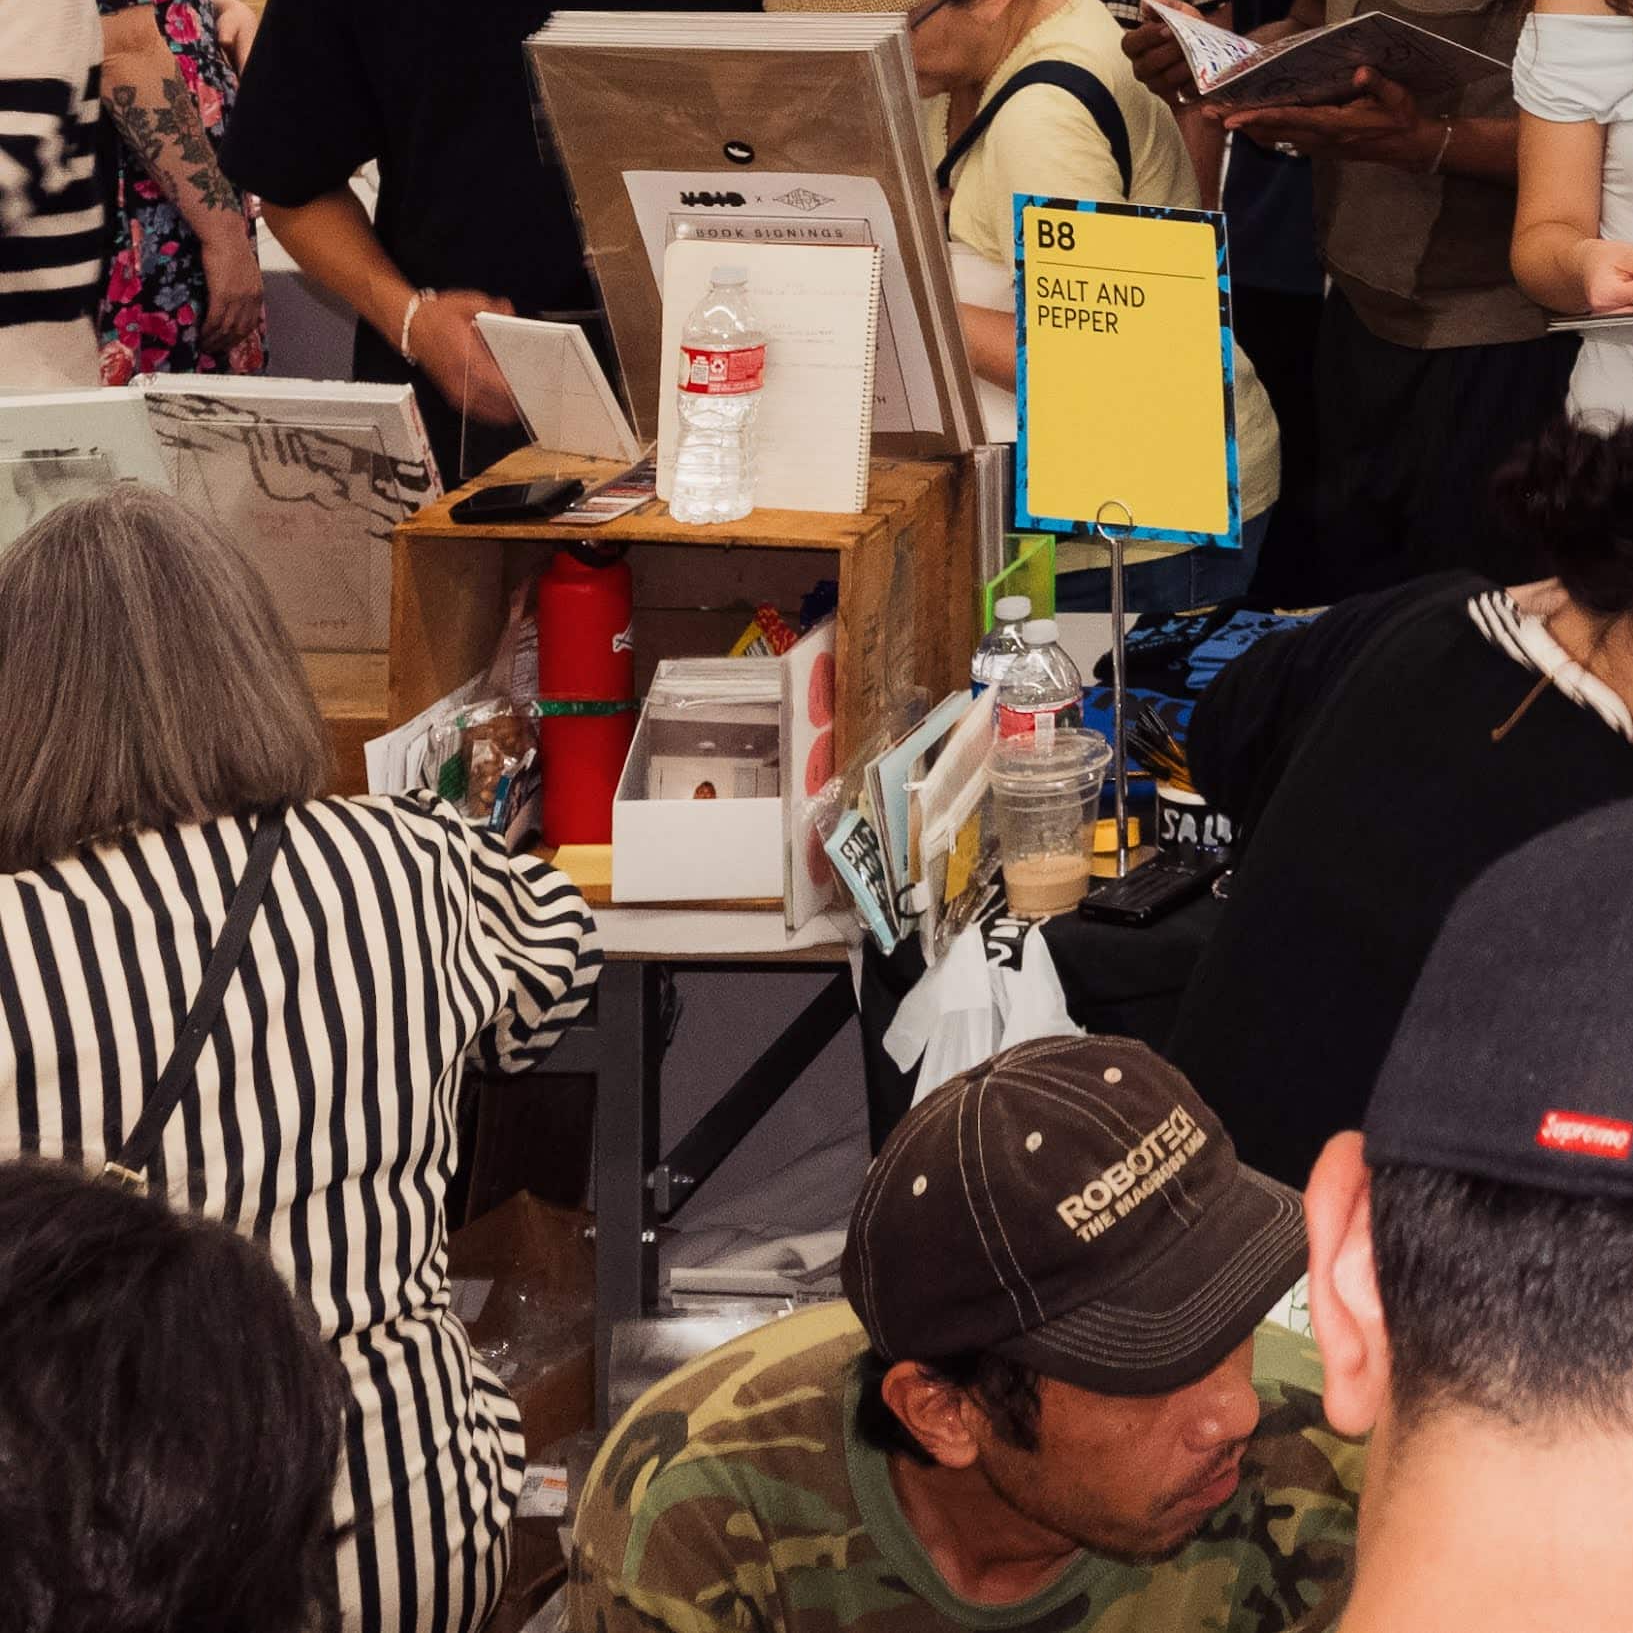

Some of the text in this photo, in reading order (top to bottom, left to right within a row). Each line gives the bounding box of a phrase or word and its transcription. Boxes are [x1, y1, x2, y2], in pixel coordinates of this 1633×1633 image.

[755, 228, 843, 238] SIGNINGS
[1037, 218, 1075, 252] B8
[1036, 277, 1146, 309] SALT AND
[1037, 306, 1119, 335] PEPPER
[1541, 1112, 1630, 1150] Supreme
[1056, 1104, 1196, 1229] ROBOTECH
[1076, 1209, 1116, 1243] THE
